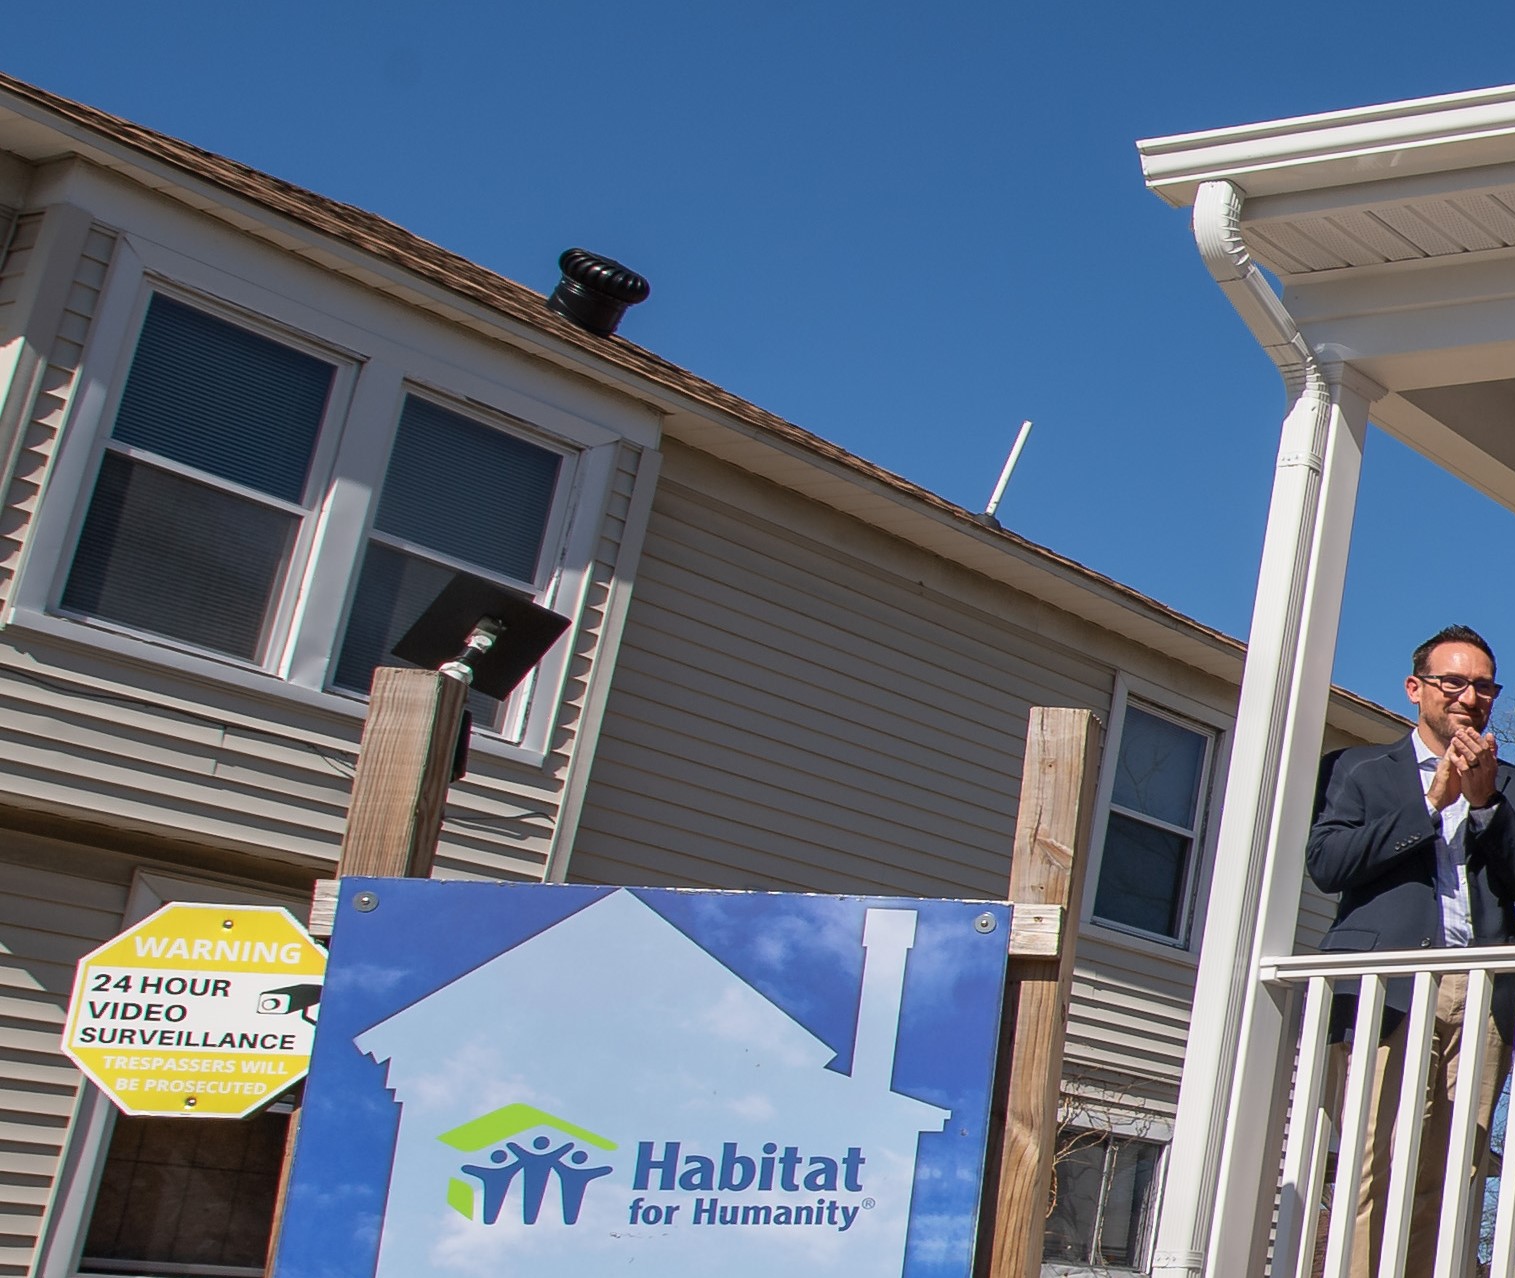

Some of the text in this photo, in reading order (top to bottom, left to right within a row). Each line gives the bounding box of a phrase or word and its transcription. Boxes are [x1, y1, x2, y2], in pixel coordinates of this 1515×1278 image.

[133, 935, 302, 965] WARNING
[91, 974, 232, 998] 24 HOUR
[88, 1001, 188, 1023] VIDEO
[79, 1027, 296, 1050] SURVEILLANCE
[103, 1055, 288, 1075] TRESPASSERS WILL
[115, 1078, 267, 1096] BE PROSECUTED
[632, 1141, 866, 1192] Habitat
[629, 1197, 681, 1226] for
